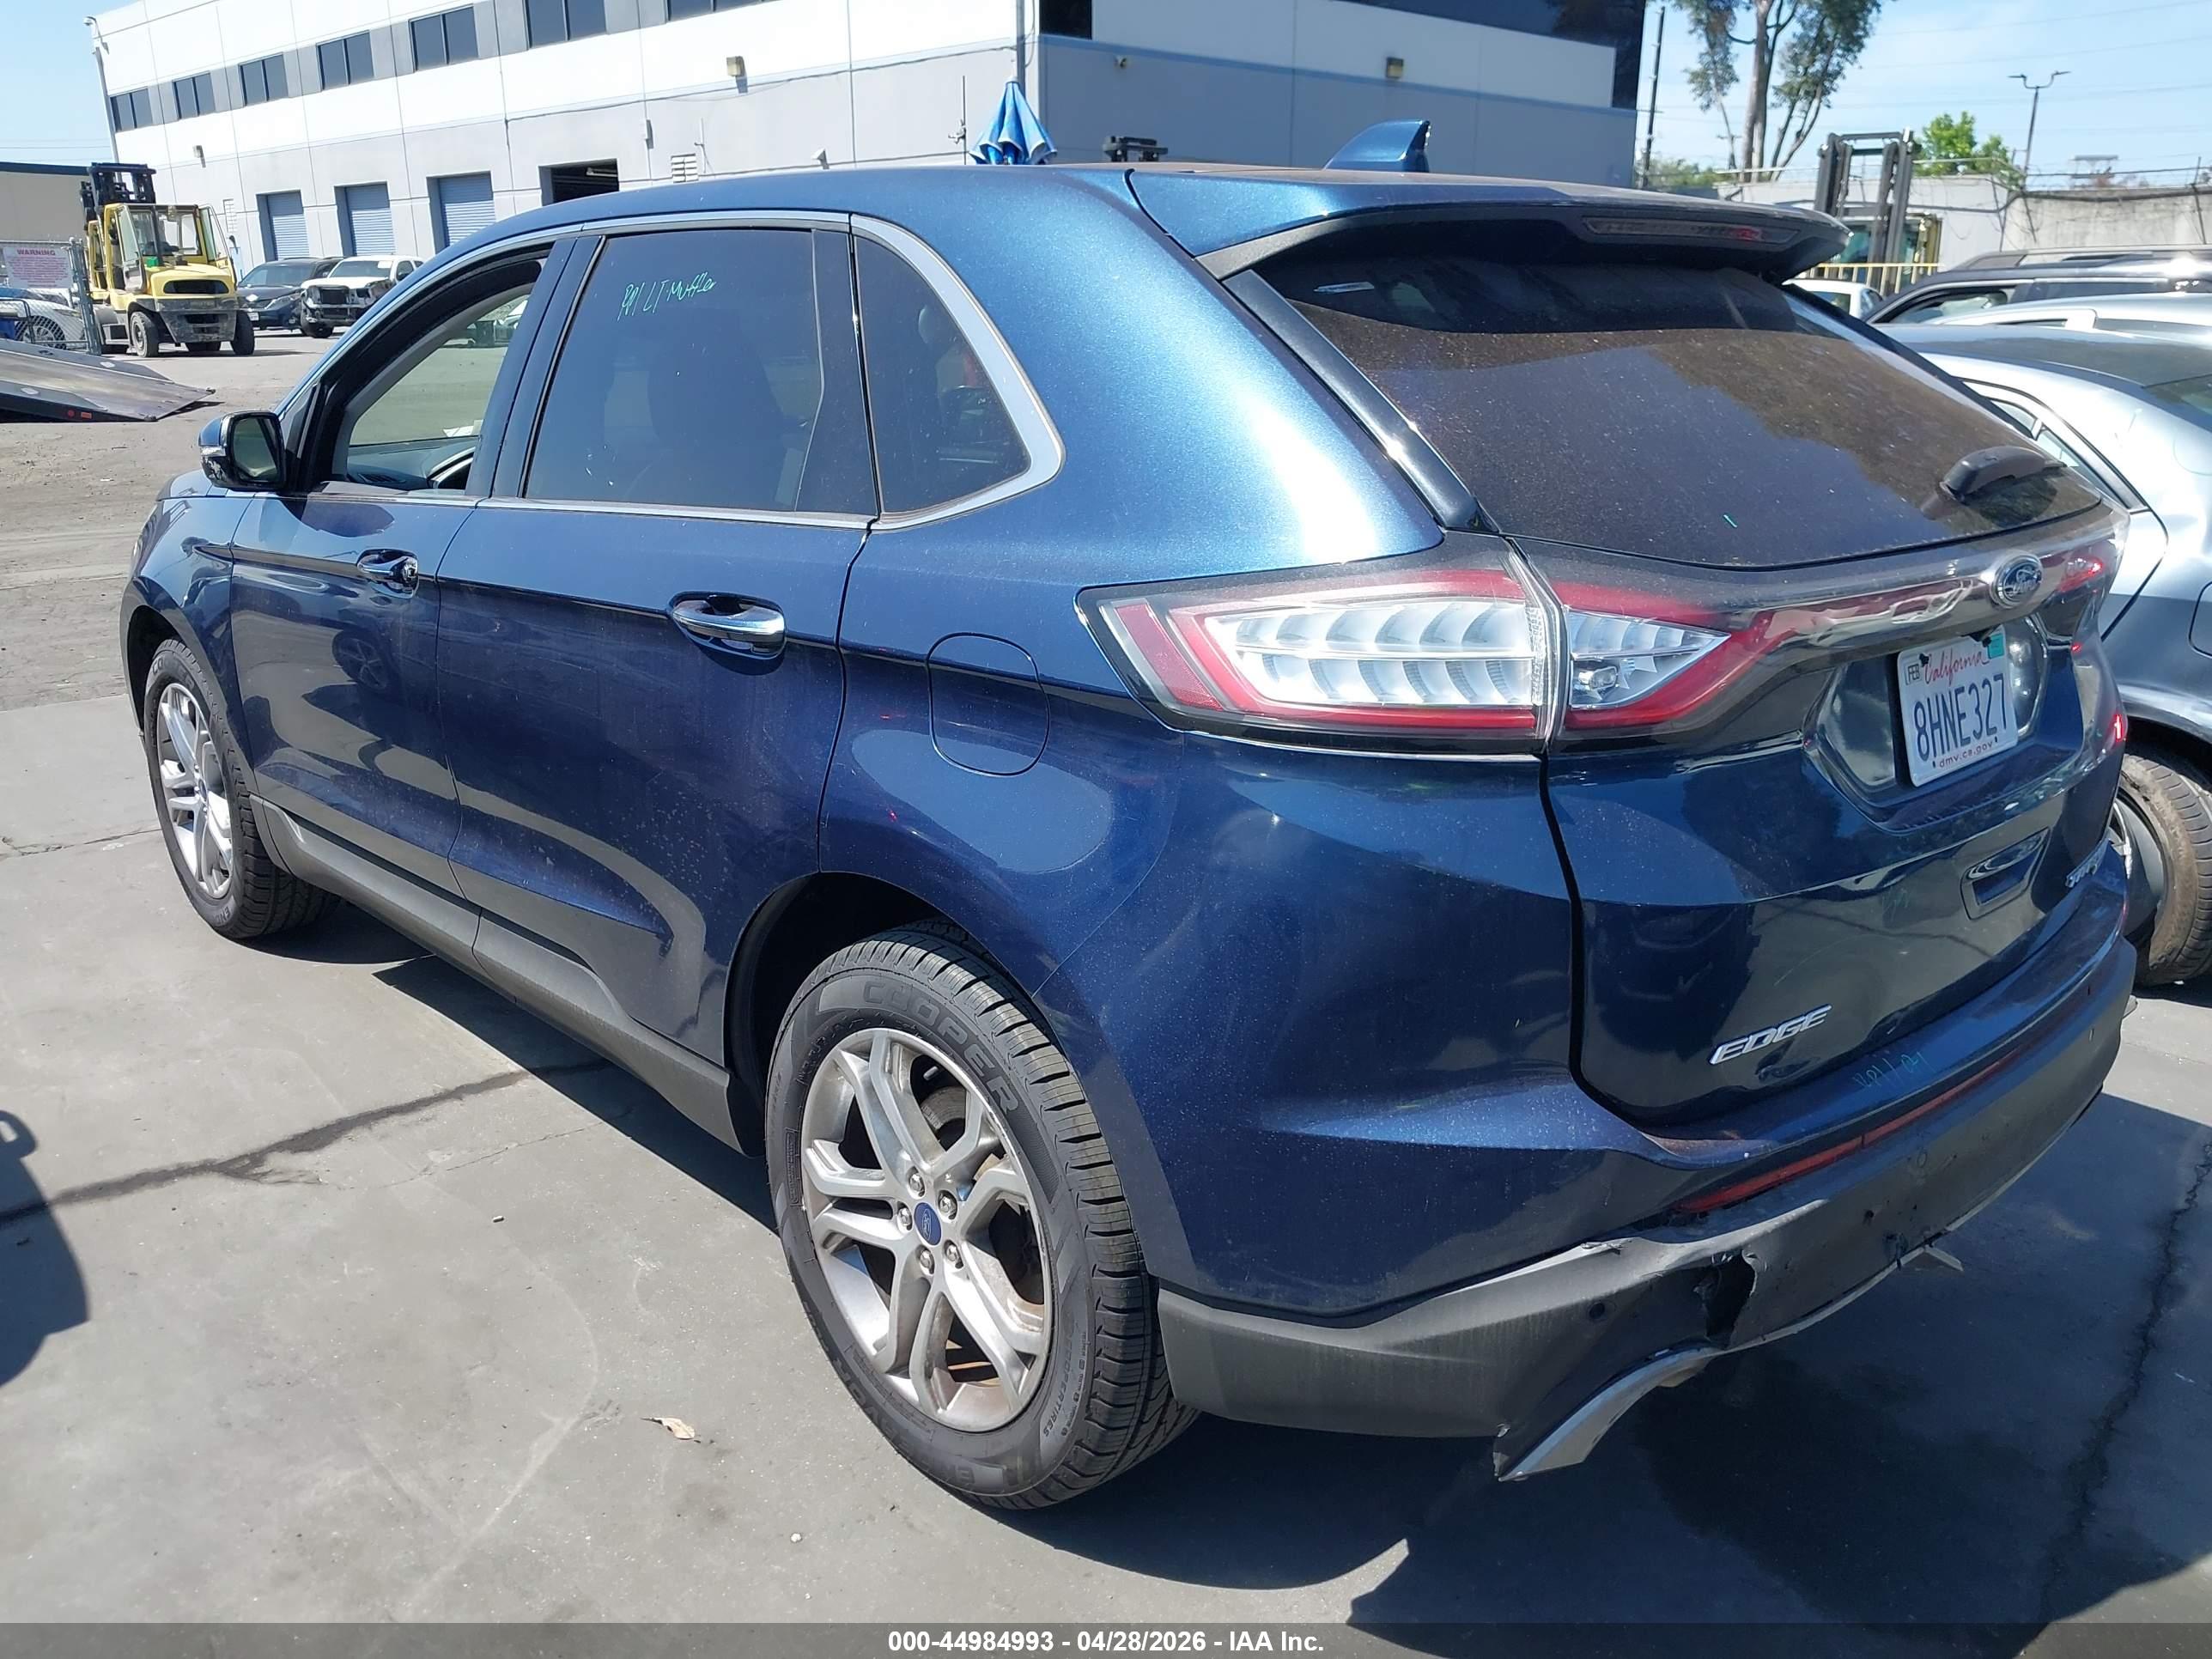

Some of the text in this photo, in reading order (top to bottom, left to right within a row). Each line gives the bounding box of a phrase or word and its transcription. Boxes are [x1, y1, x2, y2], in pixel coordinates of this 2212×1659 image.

[1907, 663, 1921, 684] FEB
[1923, 647, 1990, 685] California
[1913, 672, 2008, 762] 8HNE327
[1938, 740, 1994, 769] dmv.ca.gov
[862, 981, 1019, 1115] COOPER
[1710, 1005, 1832, 1066] EDGE
